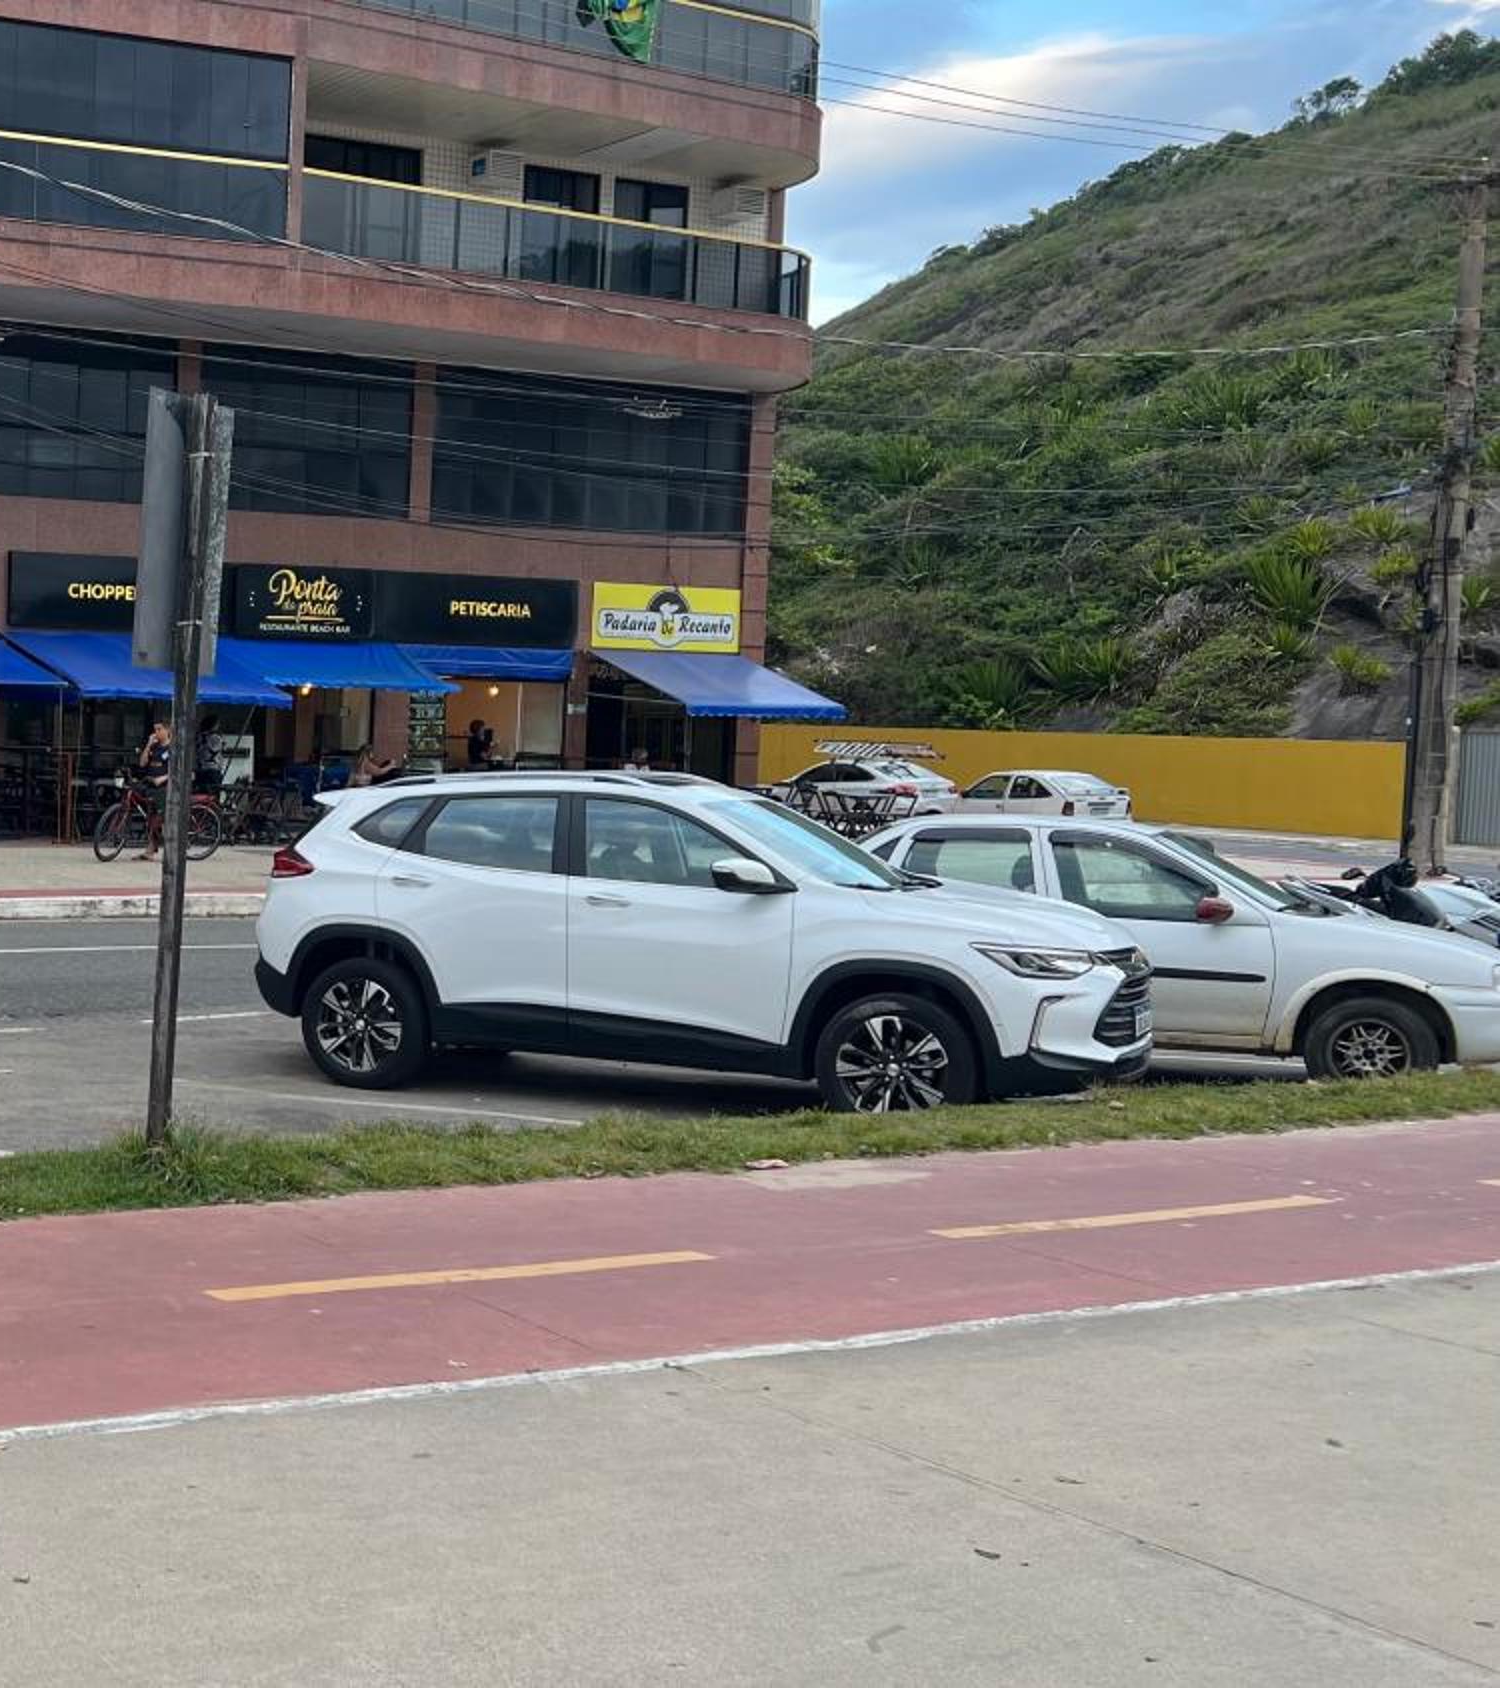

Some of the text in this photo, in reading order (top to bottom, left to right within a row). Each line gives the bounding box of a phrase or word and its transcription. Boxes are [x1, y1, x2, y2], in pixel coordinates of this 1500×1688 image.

[269, 569, 341, 605] Ponta
[296, 601, 338, 622] praia
[449, 599, 531, 619] PETISCARIA
[335, 624, 351, 633] BAR
[603, 612, 657, 632] Padaria
[679, 615, 731, 635] Recanto
